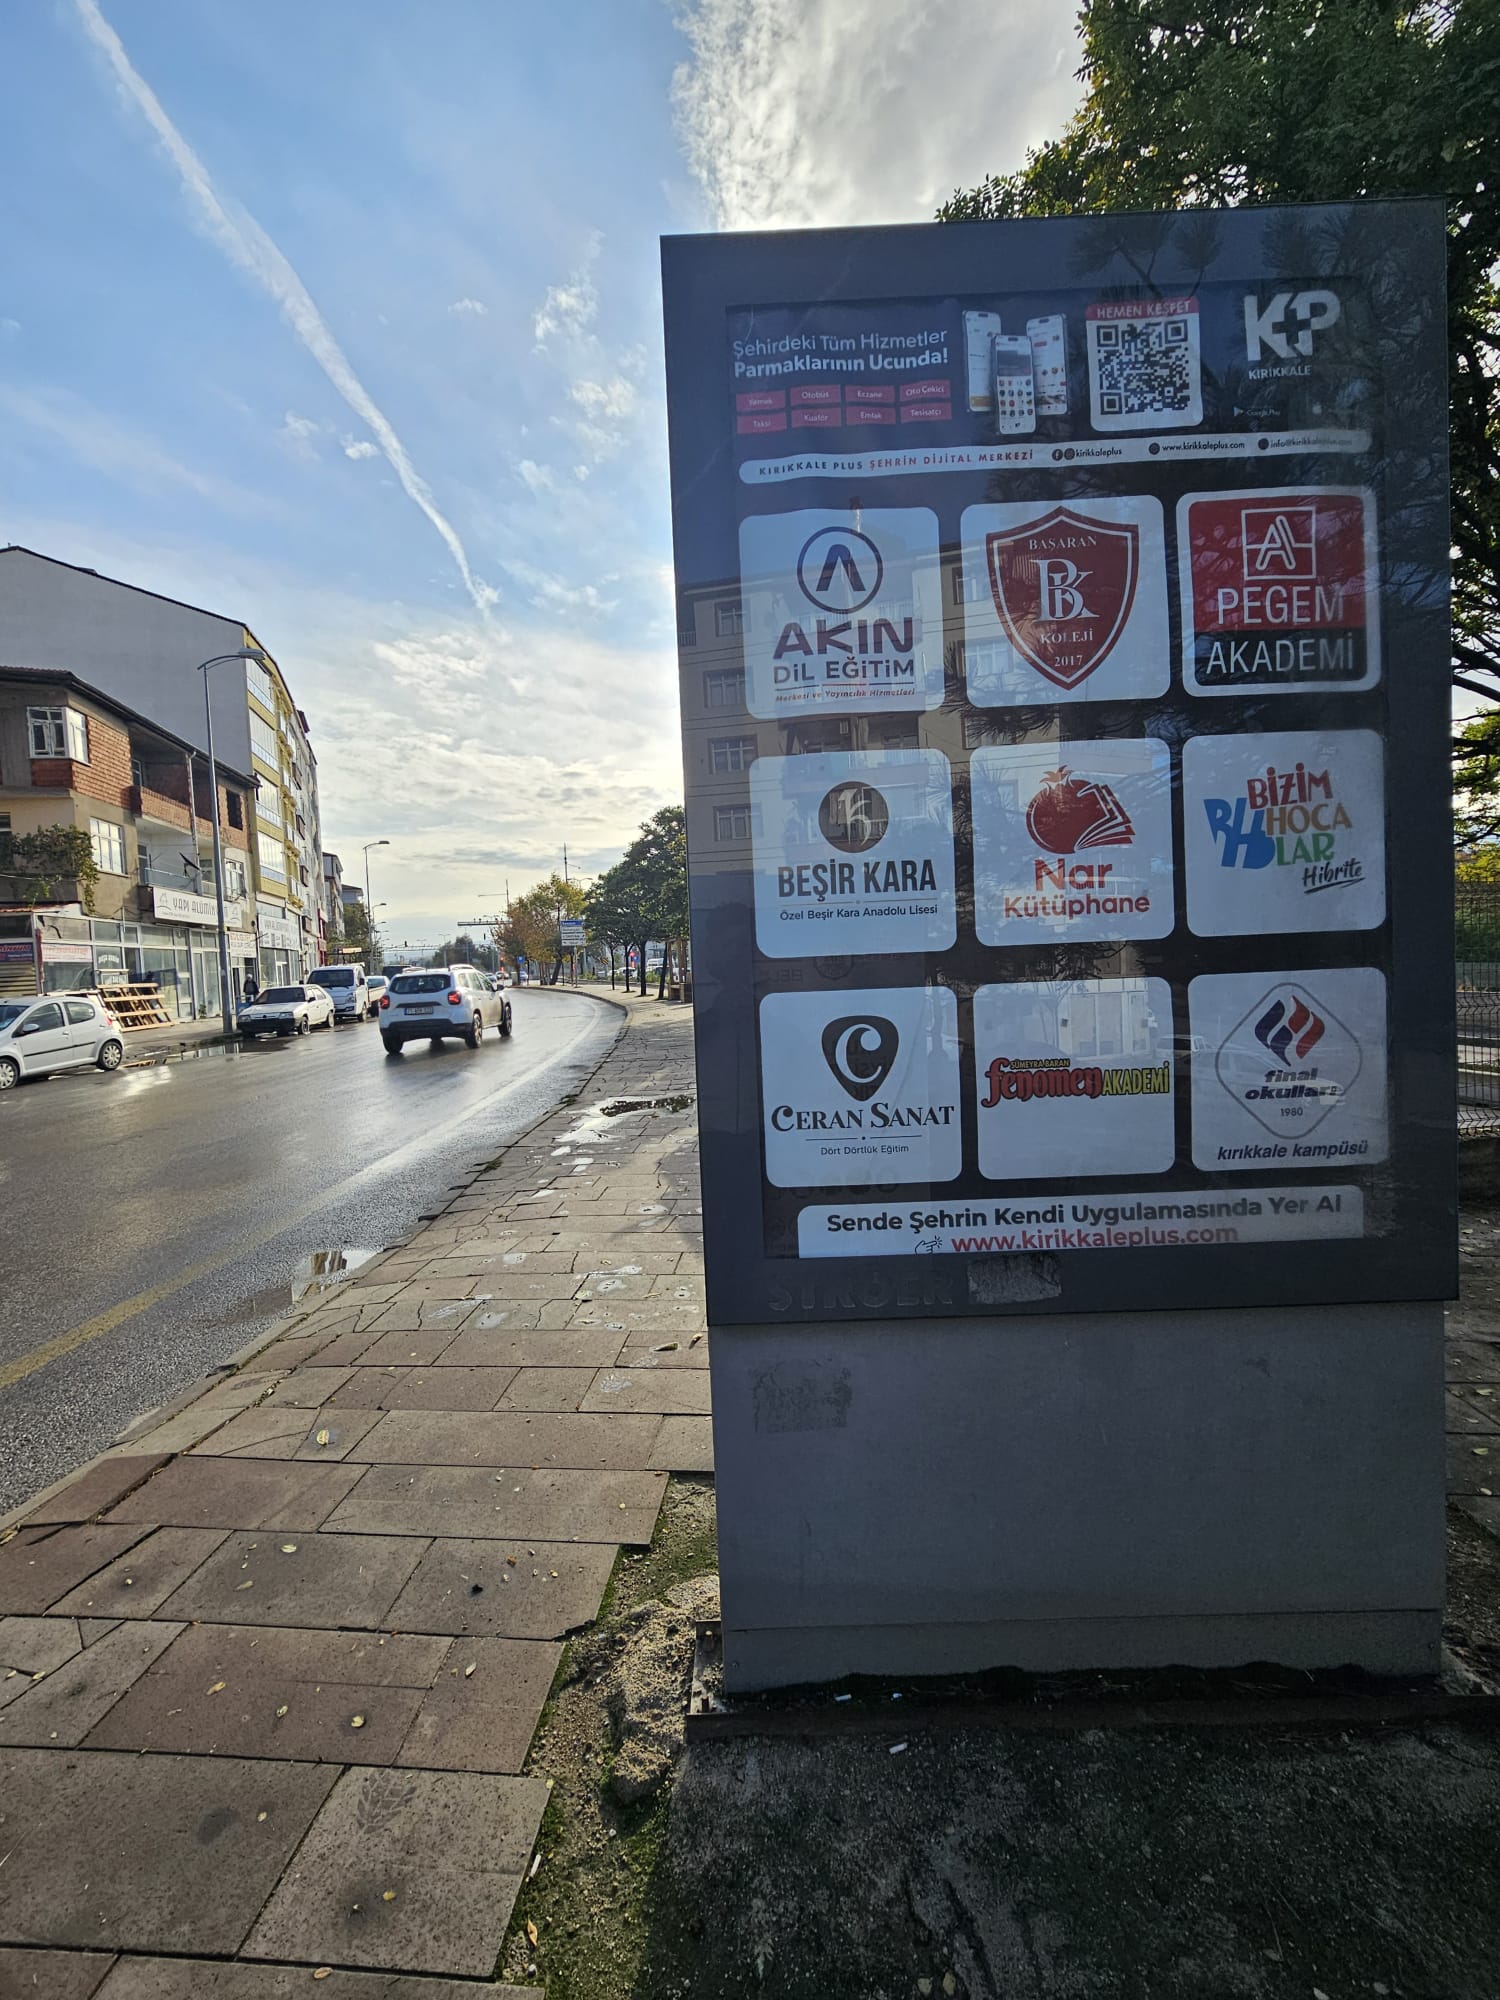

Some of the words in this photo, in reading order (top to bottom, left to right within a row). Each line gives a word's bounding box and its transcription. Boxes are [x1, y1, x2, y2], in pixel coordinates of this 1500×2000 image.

[1096, 305, 1143, 319] HEMEN
[1147, 300, 1191, 316] KEŞFET
[733, 334, 816, 360] Şehirdeki
[820, 335, 855, 351] Tüm
[860, 329, 948, 350] Hizmetler
[734, 356, 864, 378] Parmaklarının
[869, 347, 949, 370] Ucunda!
[1162, 440, 1245, 452] www.kirikkaleplus.com
[759, 461, 827, 476] KIRIKKALE
[833, 460, 863, 471] PLUS
[869, 456, 917, 471] ŞEHRİN
[923, 453, 972, 465] DİJİTAL
[978, 449, 1033, 462] MERKEZİ
[1029, 535, 1097, 551] BAŞARAN
[1217, 584, 1344, 625] PEGEM
[773, 617, 914, 660] AKIN
[1206, 632, 1353, 674] AKADEMİ
[1054, 655, 1083, 667] 2017
[1247, 762, 1333, 810] BİZİM
[1266, 802, 1353, 836] HOCA
[1276, 833, 1335, 866] LAR
[778, 858, 855, 901] BEŞİR
[864, 859, 937, 894] KARA
[1034, 858, 1113, 891] Nar
[780, 909, 804, 921] Özel
[808, 909, 833, 921] Beşir
[837, 909, 860, 919] Kara
[862, 906, 906, 917] Anadolu
[910, 904, 938, 915] Lisesi
[1004, 893, 1150, 920] Kütüphane
[1045, 1058, 1070, 1068] BARAN
[1265, 1068, 1318, 1083] final
[981, 1057, 1103, 1108] fenomen
[1102, 1061, 1170, 1096] AKADEMİ
[771, 1105, 864, 1132] CERAN
[870, 1102, 955, 1129] SANAT
[1280, 1107, 1304, 1117] 1980
[820, 1146, 841, 1156] Dört
[844, 1145, 878, 1155] Dörtlük
[880, 1144, 909, 1155] Eğitim
[1217, 1143, 1287, 1161] kırıkkale
[1292, 1140, 1368, 1159] kampüsü
[827, 1212, 902, 1232] Sende
[910, 1207, 986, 1234] Şehrin
[994, 1204, 1064, 1226] Kendi
[1071, 1197, 1263, 1226] Uygulamasında
[1268, 1196, 1309, 1215] Yer
[951, 1225, 1239, 1253] www.kirikkaleplus.com
